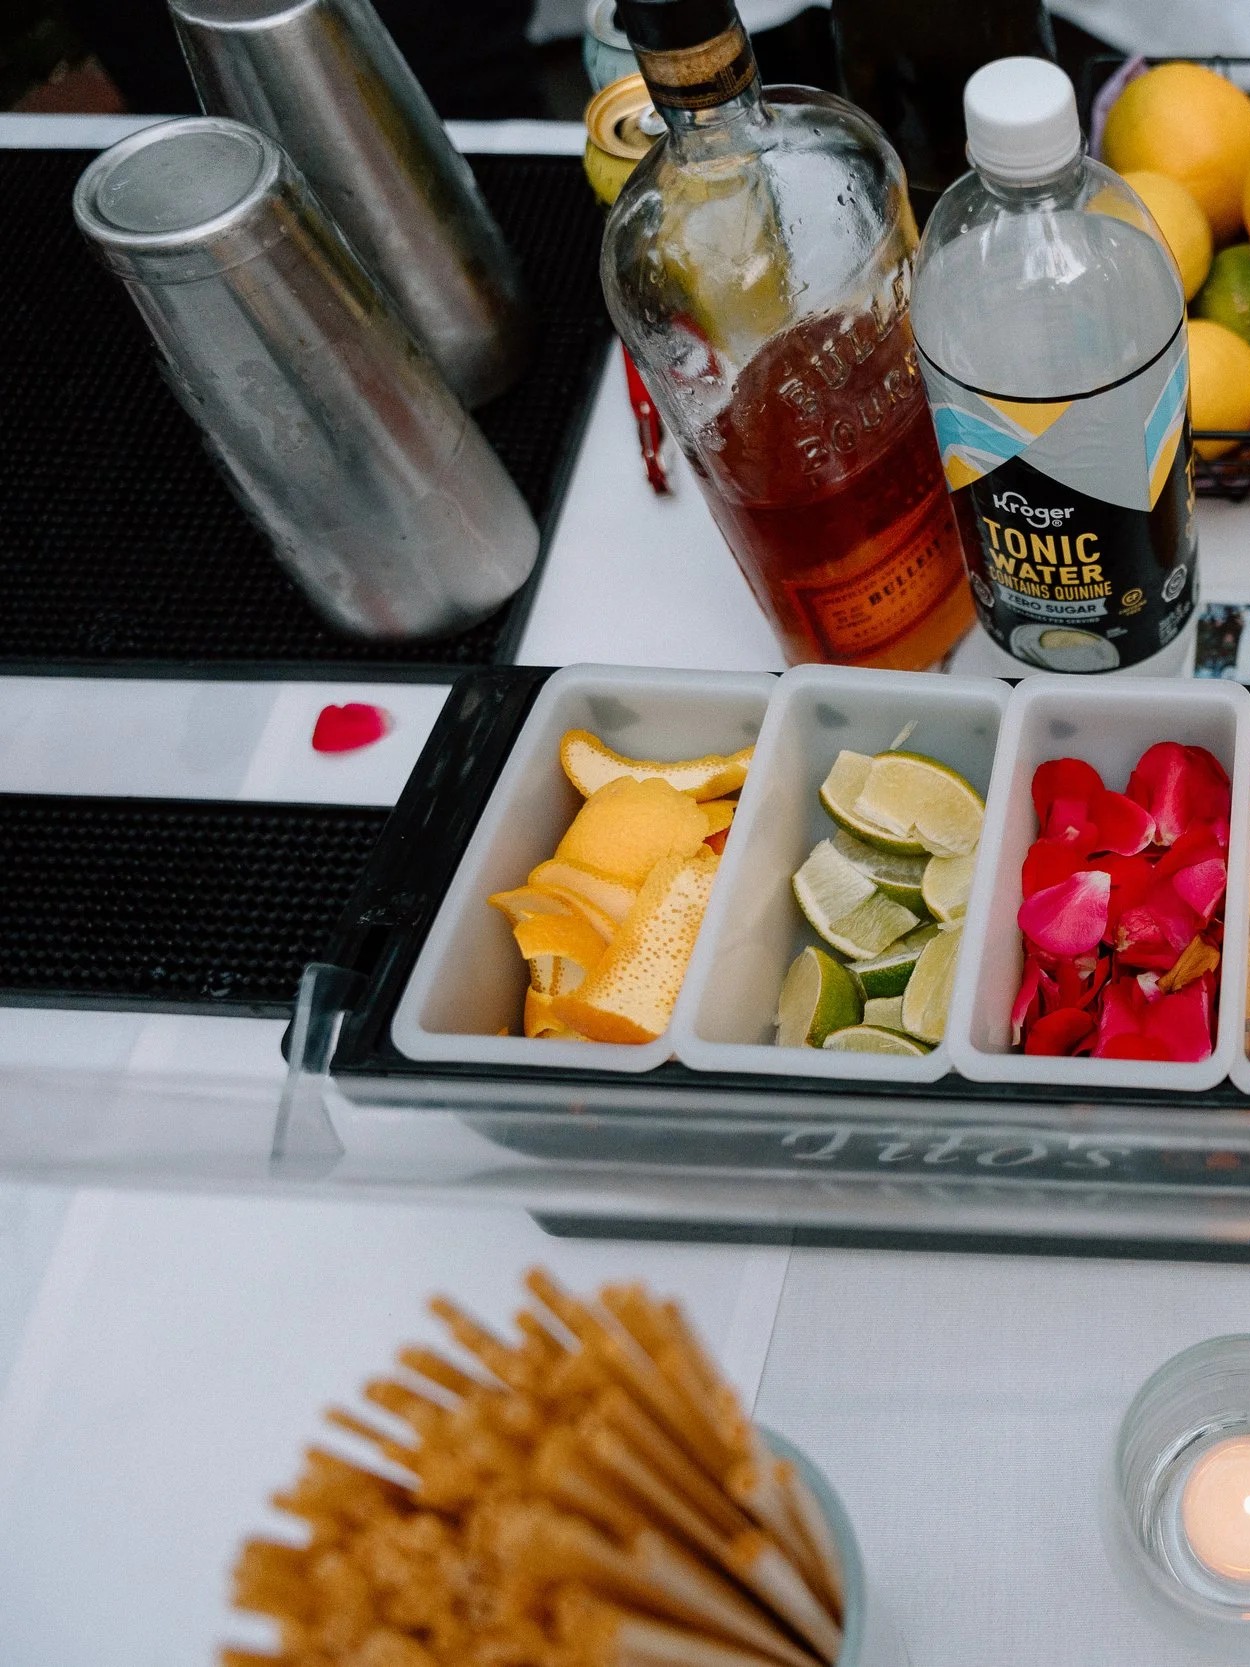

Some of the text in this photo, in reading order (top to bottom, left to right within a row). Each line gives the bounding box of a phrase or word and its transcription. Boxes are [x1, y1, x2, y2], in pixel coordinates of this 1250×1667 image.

[992, 491, 1075, 528] Kroger
[982, 516, 1101, 565] TONIC
[988, 547, 1105, 585] WATER
[989, 565, 1113, 601] CONTAINS QUININE
[1007, 592, 1097, 614] ZERO SUGAR
